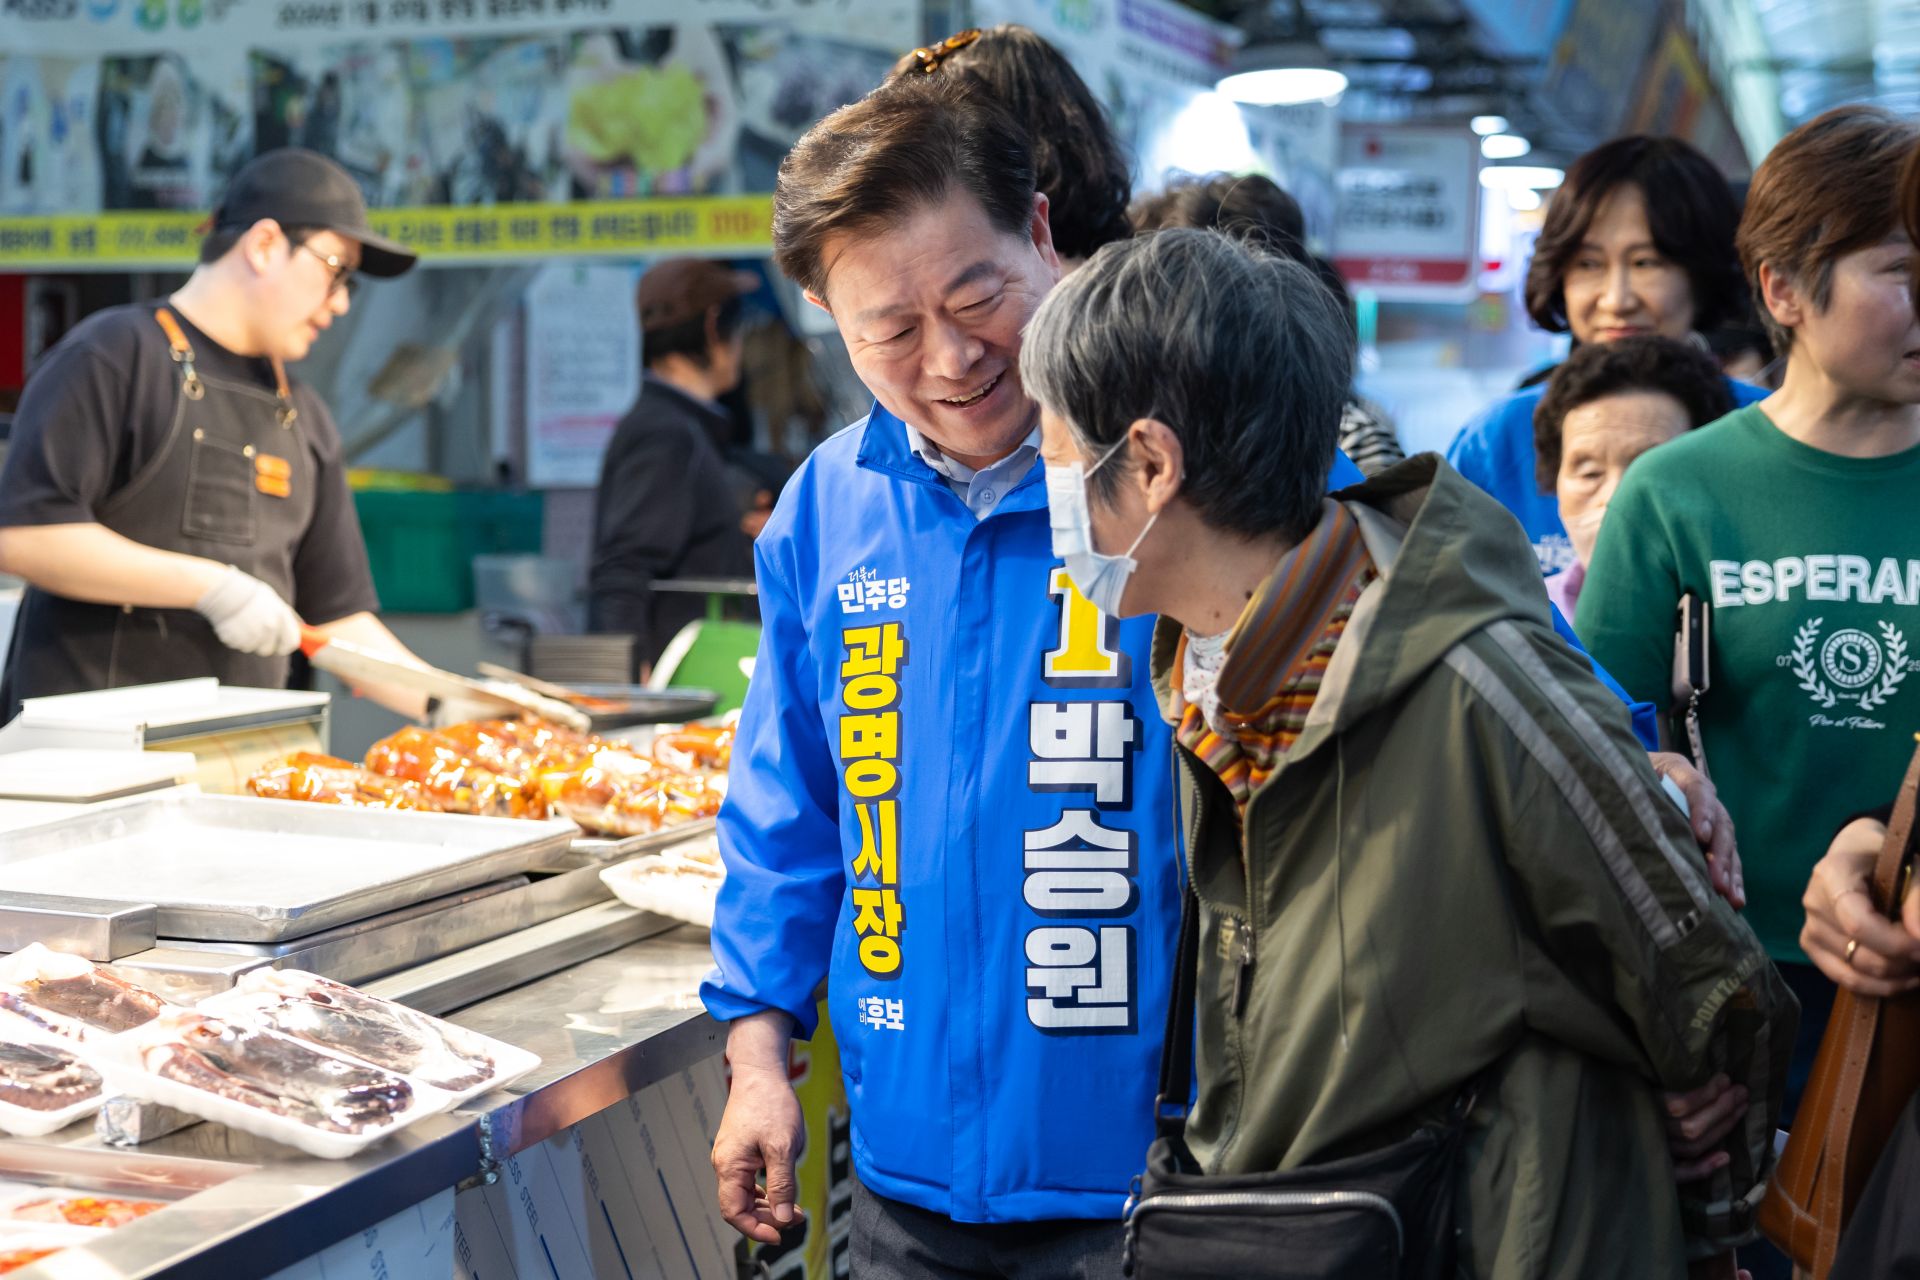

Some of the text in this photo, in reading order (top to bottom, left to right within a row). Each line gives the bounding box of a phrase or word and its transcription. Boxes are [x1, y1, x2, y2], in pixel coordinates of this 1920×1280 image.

[837, 576, 911, 614] 민주당
[847, 565, 877, 584] 더불어
[1044, 567, 1119, 679] 1
[1775, 654, 1792, 667] 07
[1839, 642, 1862, 674] S
[840, 621, 906, 977] 광명시장
[1022, 702, 1136, 1030] 박승원
[866, 996, 905, 1031] 후보
[519, 1185, 541, 1236] STEEL
[454, 1221, 474, 1273] STEEL
